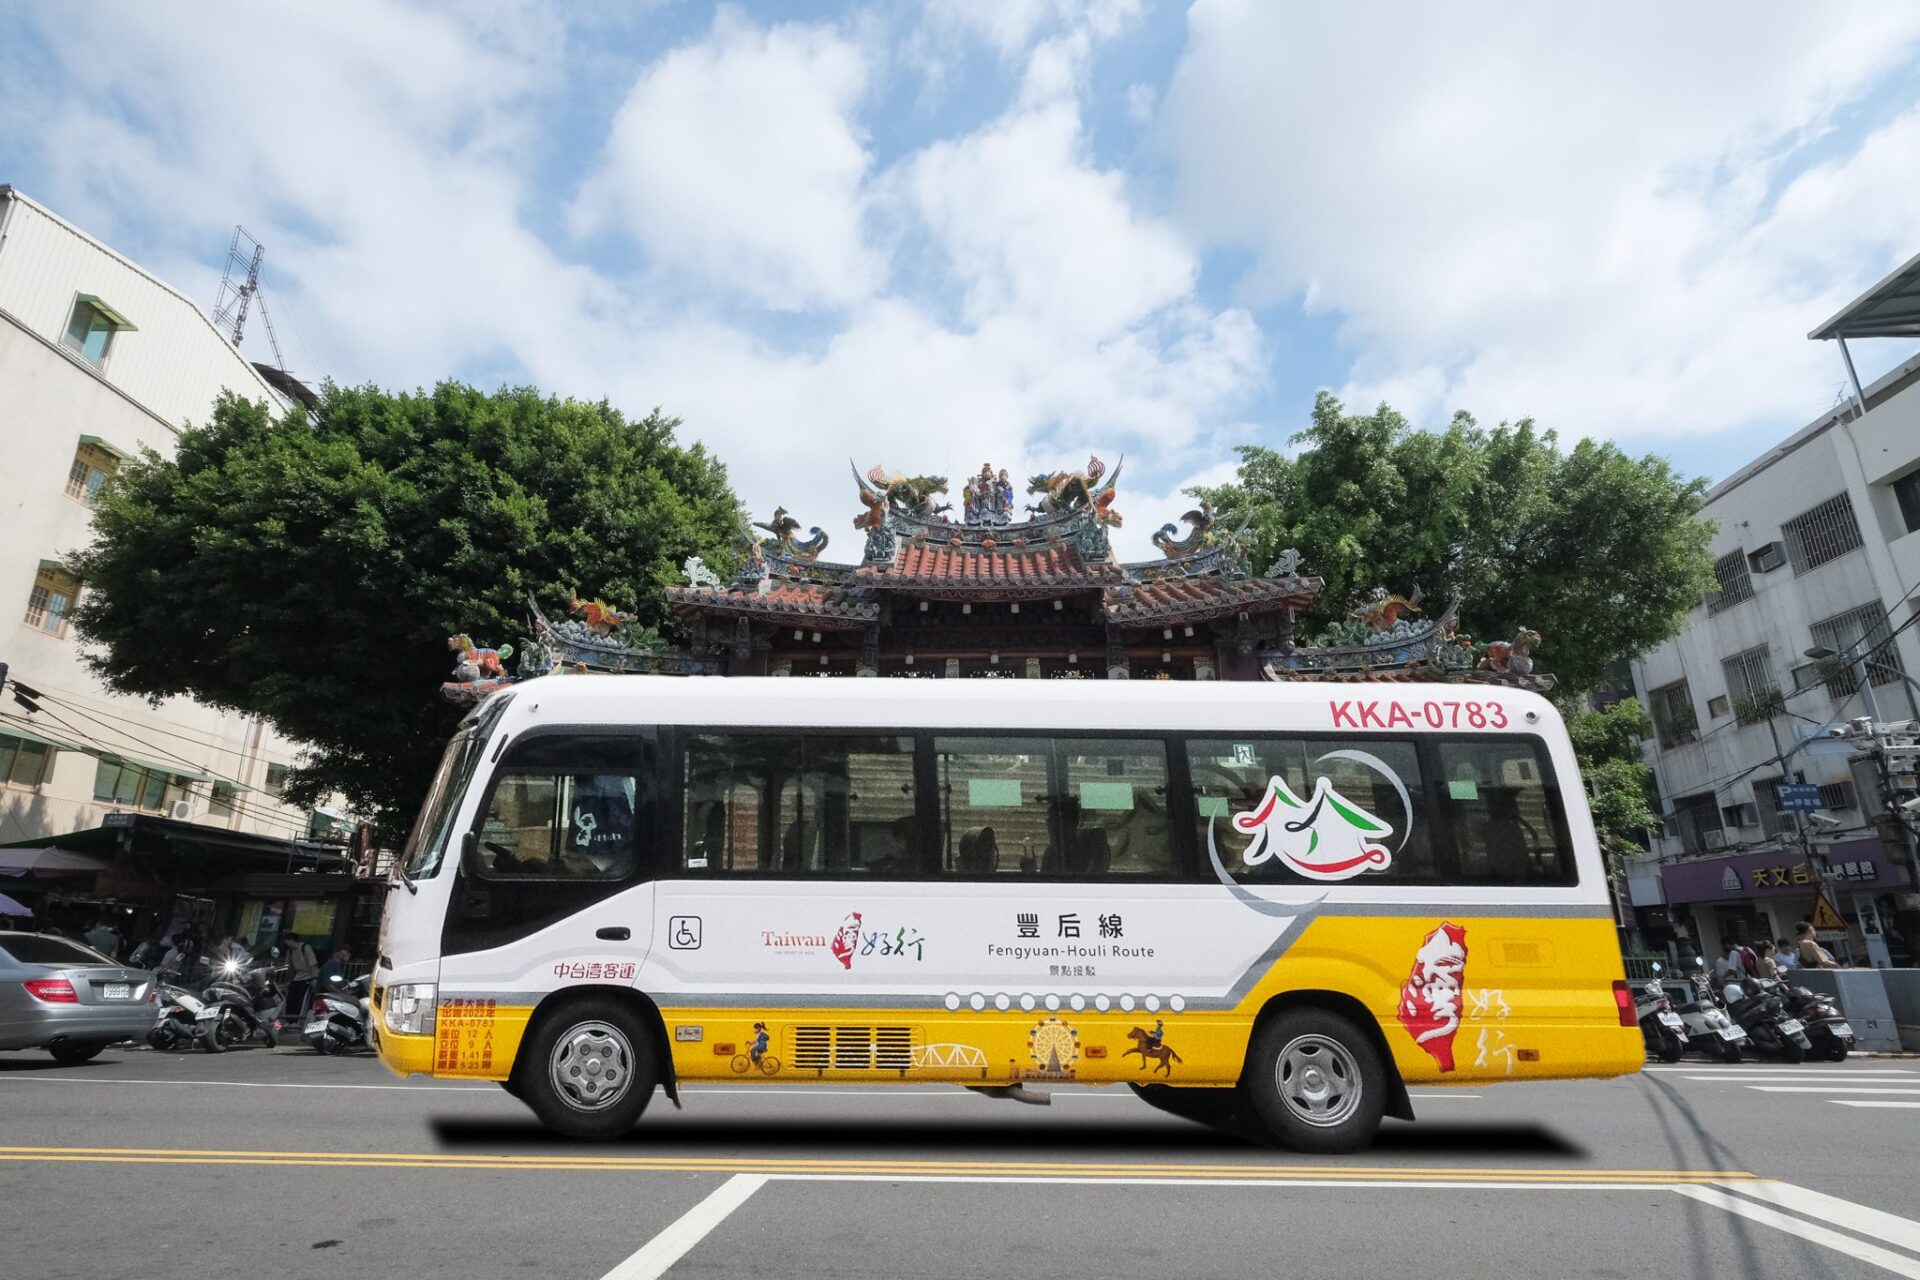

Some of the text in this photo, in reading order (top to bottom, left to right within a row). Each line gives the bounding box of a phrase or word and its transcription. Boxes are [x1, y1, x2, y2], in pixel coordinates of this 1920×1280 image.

[1329, 700, 1508, 729] KKA-0783
[1752, 862, 1809, 887] 天文台
[1016, 912, 1124, 939] 豐后線
[761, 931, 827, 947] Taiwan
[988, 944, 1155, 959] Fengyuan-Houli Route
[441, 1019, 495, 1027] KKA-0783
[468, 1030, 478, 1038] 12
[484, 1030, 493, 1039] 人
[468, 1041, 474, 1049] 9
[484, 1040, 492, 1049] 人
